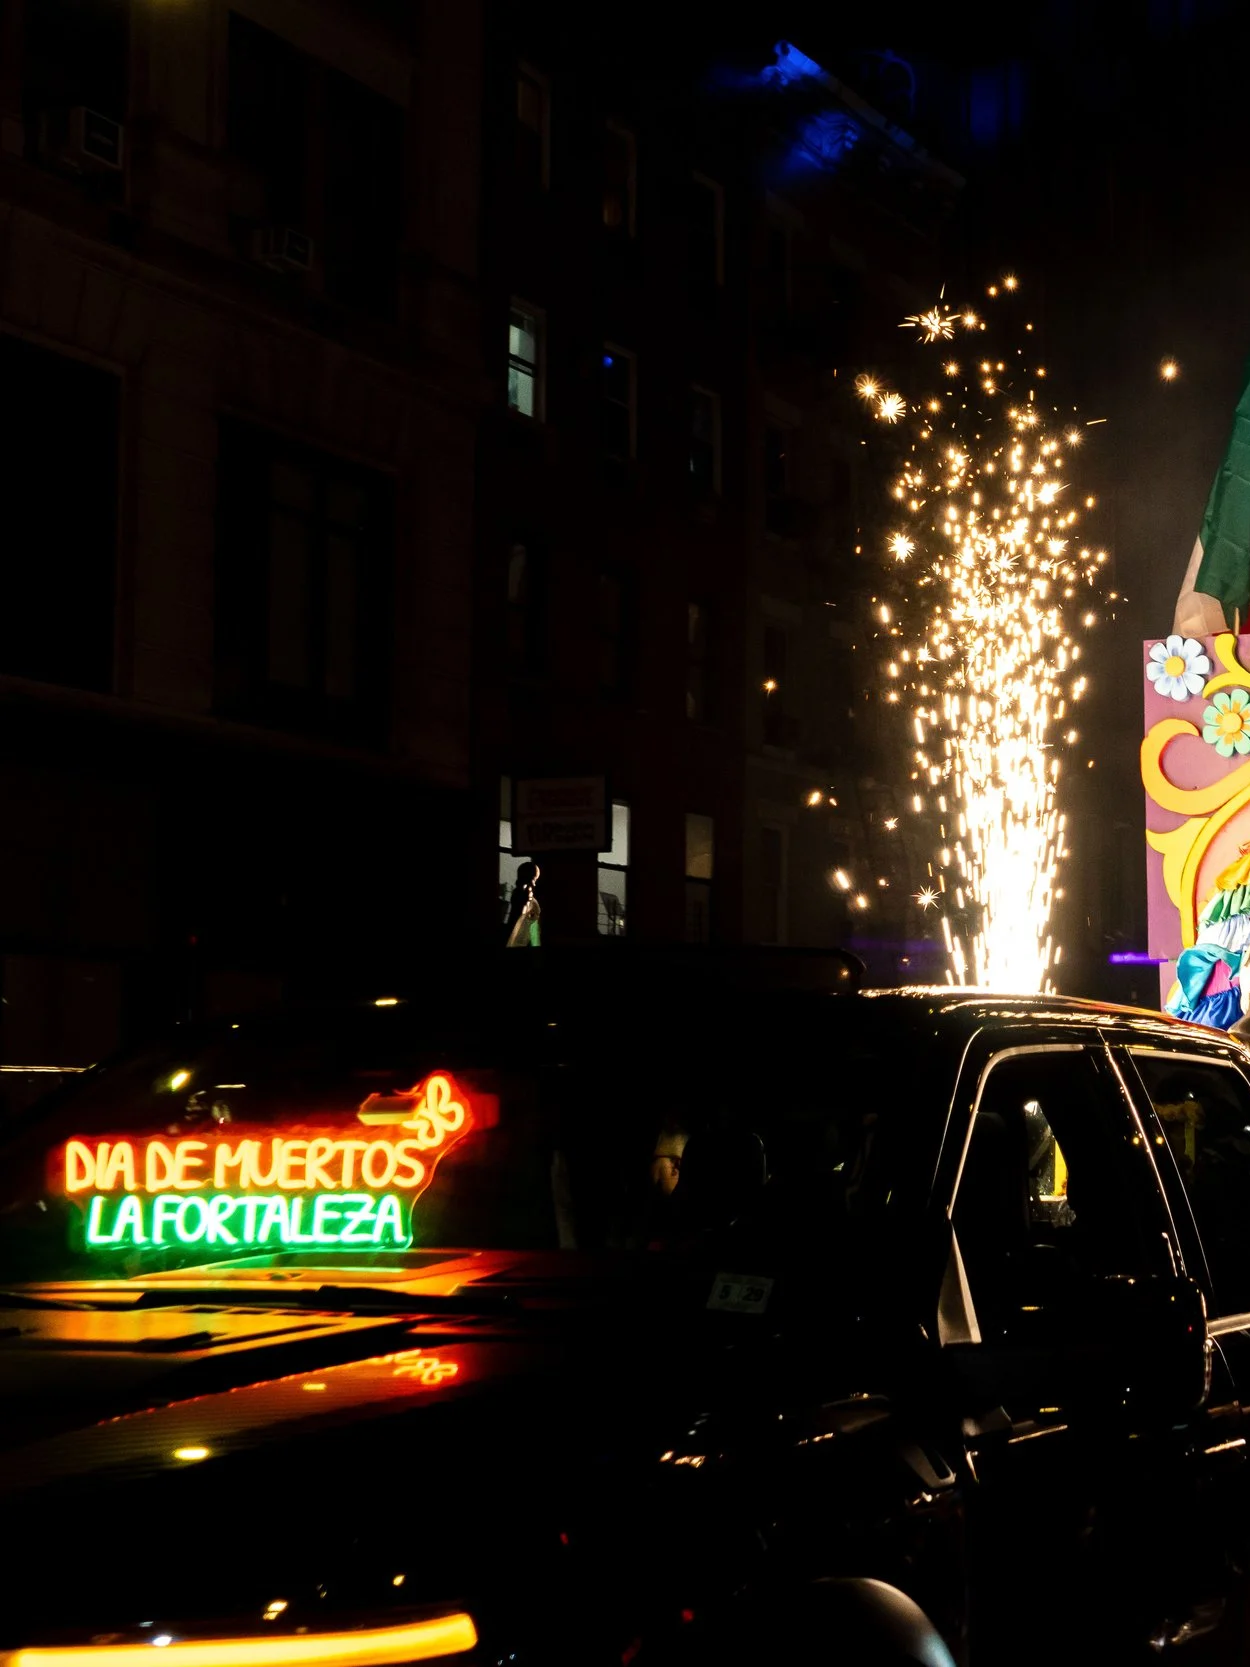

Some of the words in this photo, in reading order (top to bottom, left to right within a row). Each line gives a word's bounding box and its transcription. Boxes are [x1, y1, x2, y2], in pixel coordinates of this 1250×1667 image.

[66, 1140, 136, 1192] DIA
[145, 1141, 207, 1191] DE
[214, 1137, 424, 1190] MUERTOS
[87, 1195, 144, 1243] LA
[152, 1194, 406, 1243] FORTALEZA
[742, 1286, 764, 1302] 29
